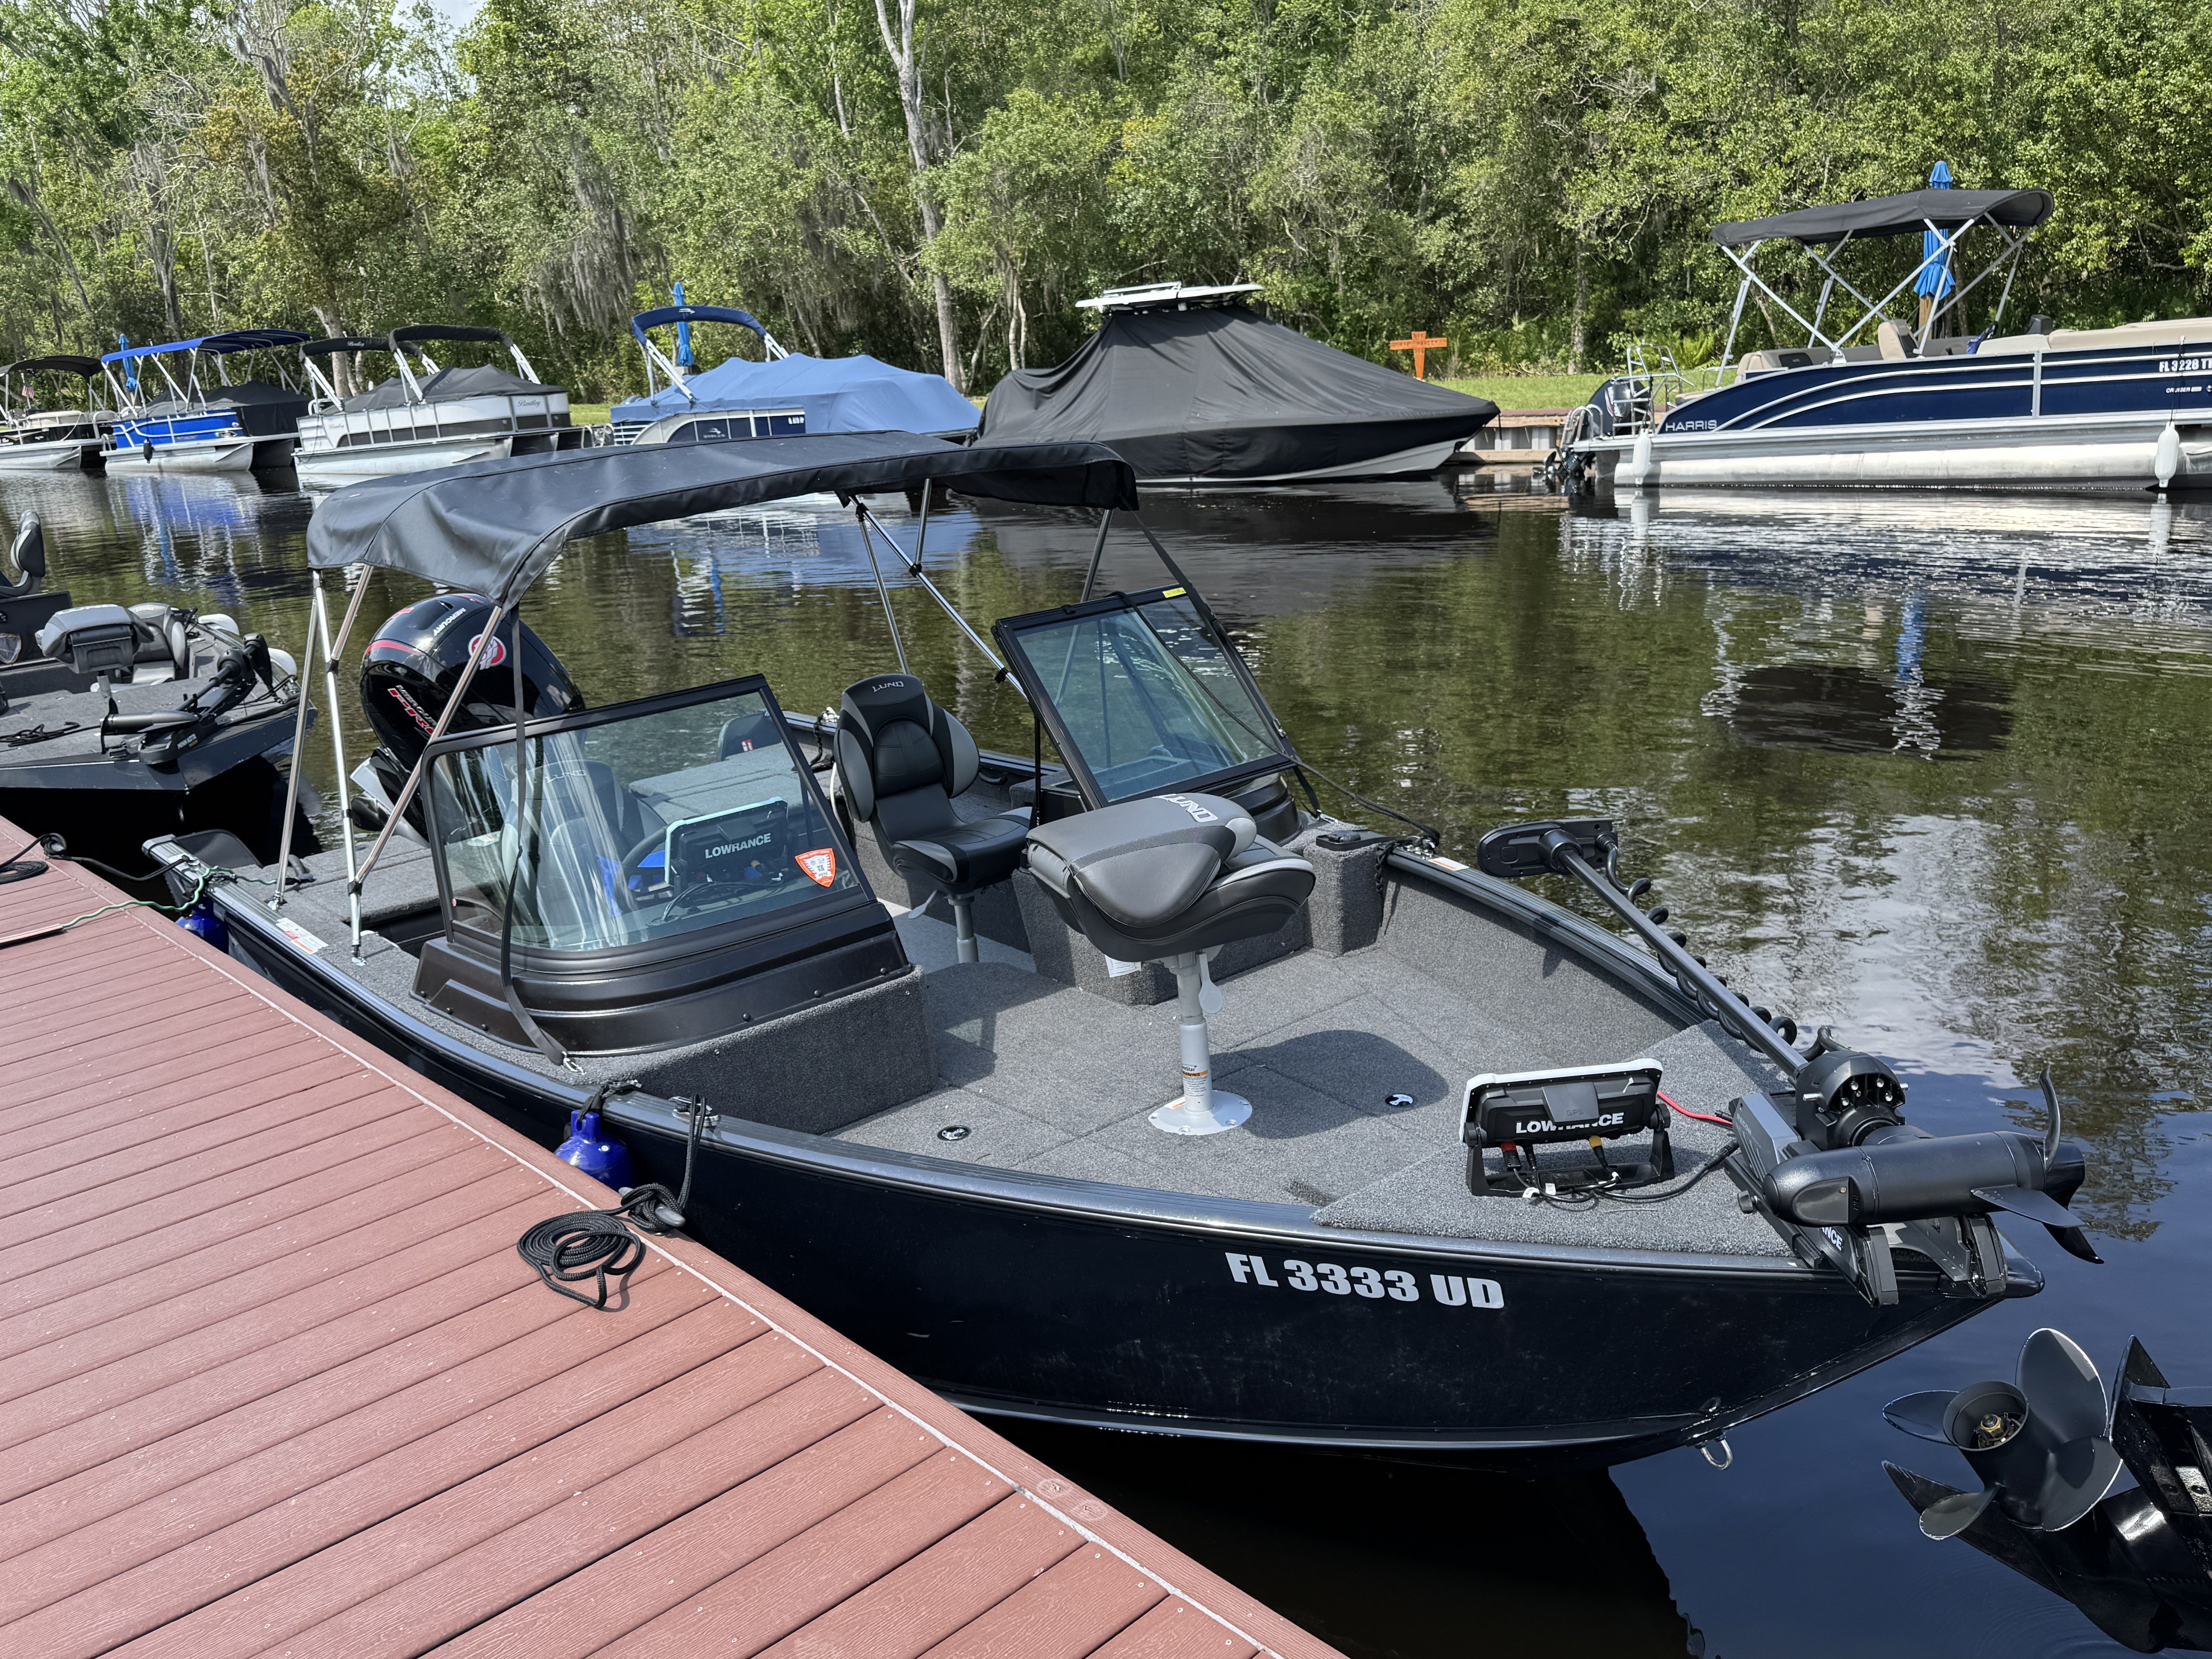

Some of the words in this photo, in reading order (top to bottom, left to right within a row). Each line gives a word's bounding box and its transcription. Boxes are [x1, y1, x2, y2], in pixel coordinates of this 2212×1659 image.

[2159, 361, 2170, 372] FL
[2171, 359, 2199, 371] 3228
[517, 399, 541, 408] Bentley
[1666, 419, 1717, 432] HARRIS
[433, 608, 466, 636] MERCURY
[872, 681, 904, 692] LUND
[395, 685, 437, 727] MERCUR
[1152, 793, 1218, 823] LUND
[705, 833, 771, 859] LOWRANCE
[1225, 1252, 1279, 1287] FL
[1283, 1259, 1420, 1302] 3333
[1430, 1274, 1505, 1309] UD
